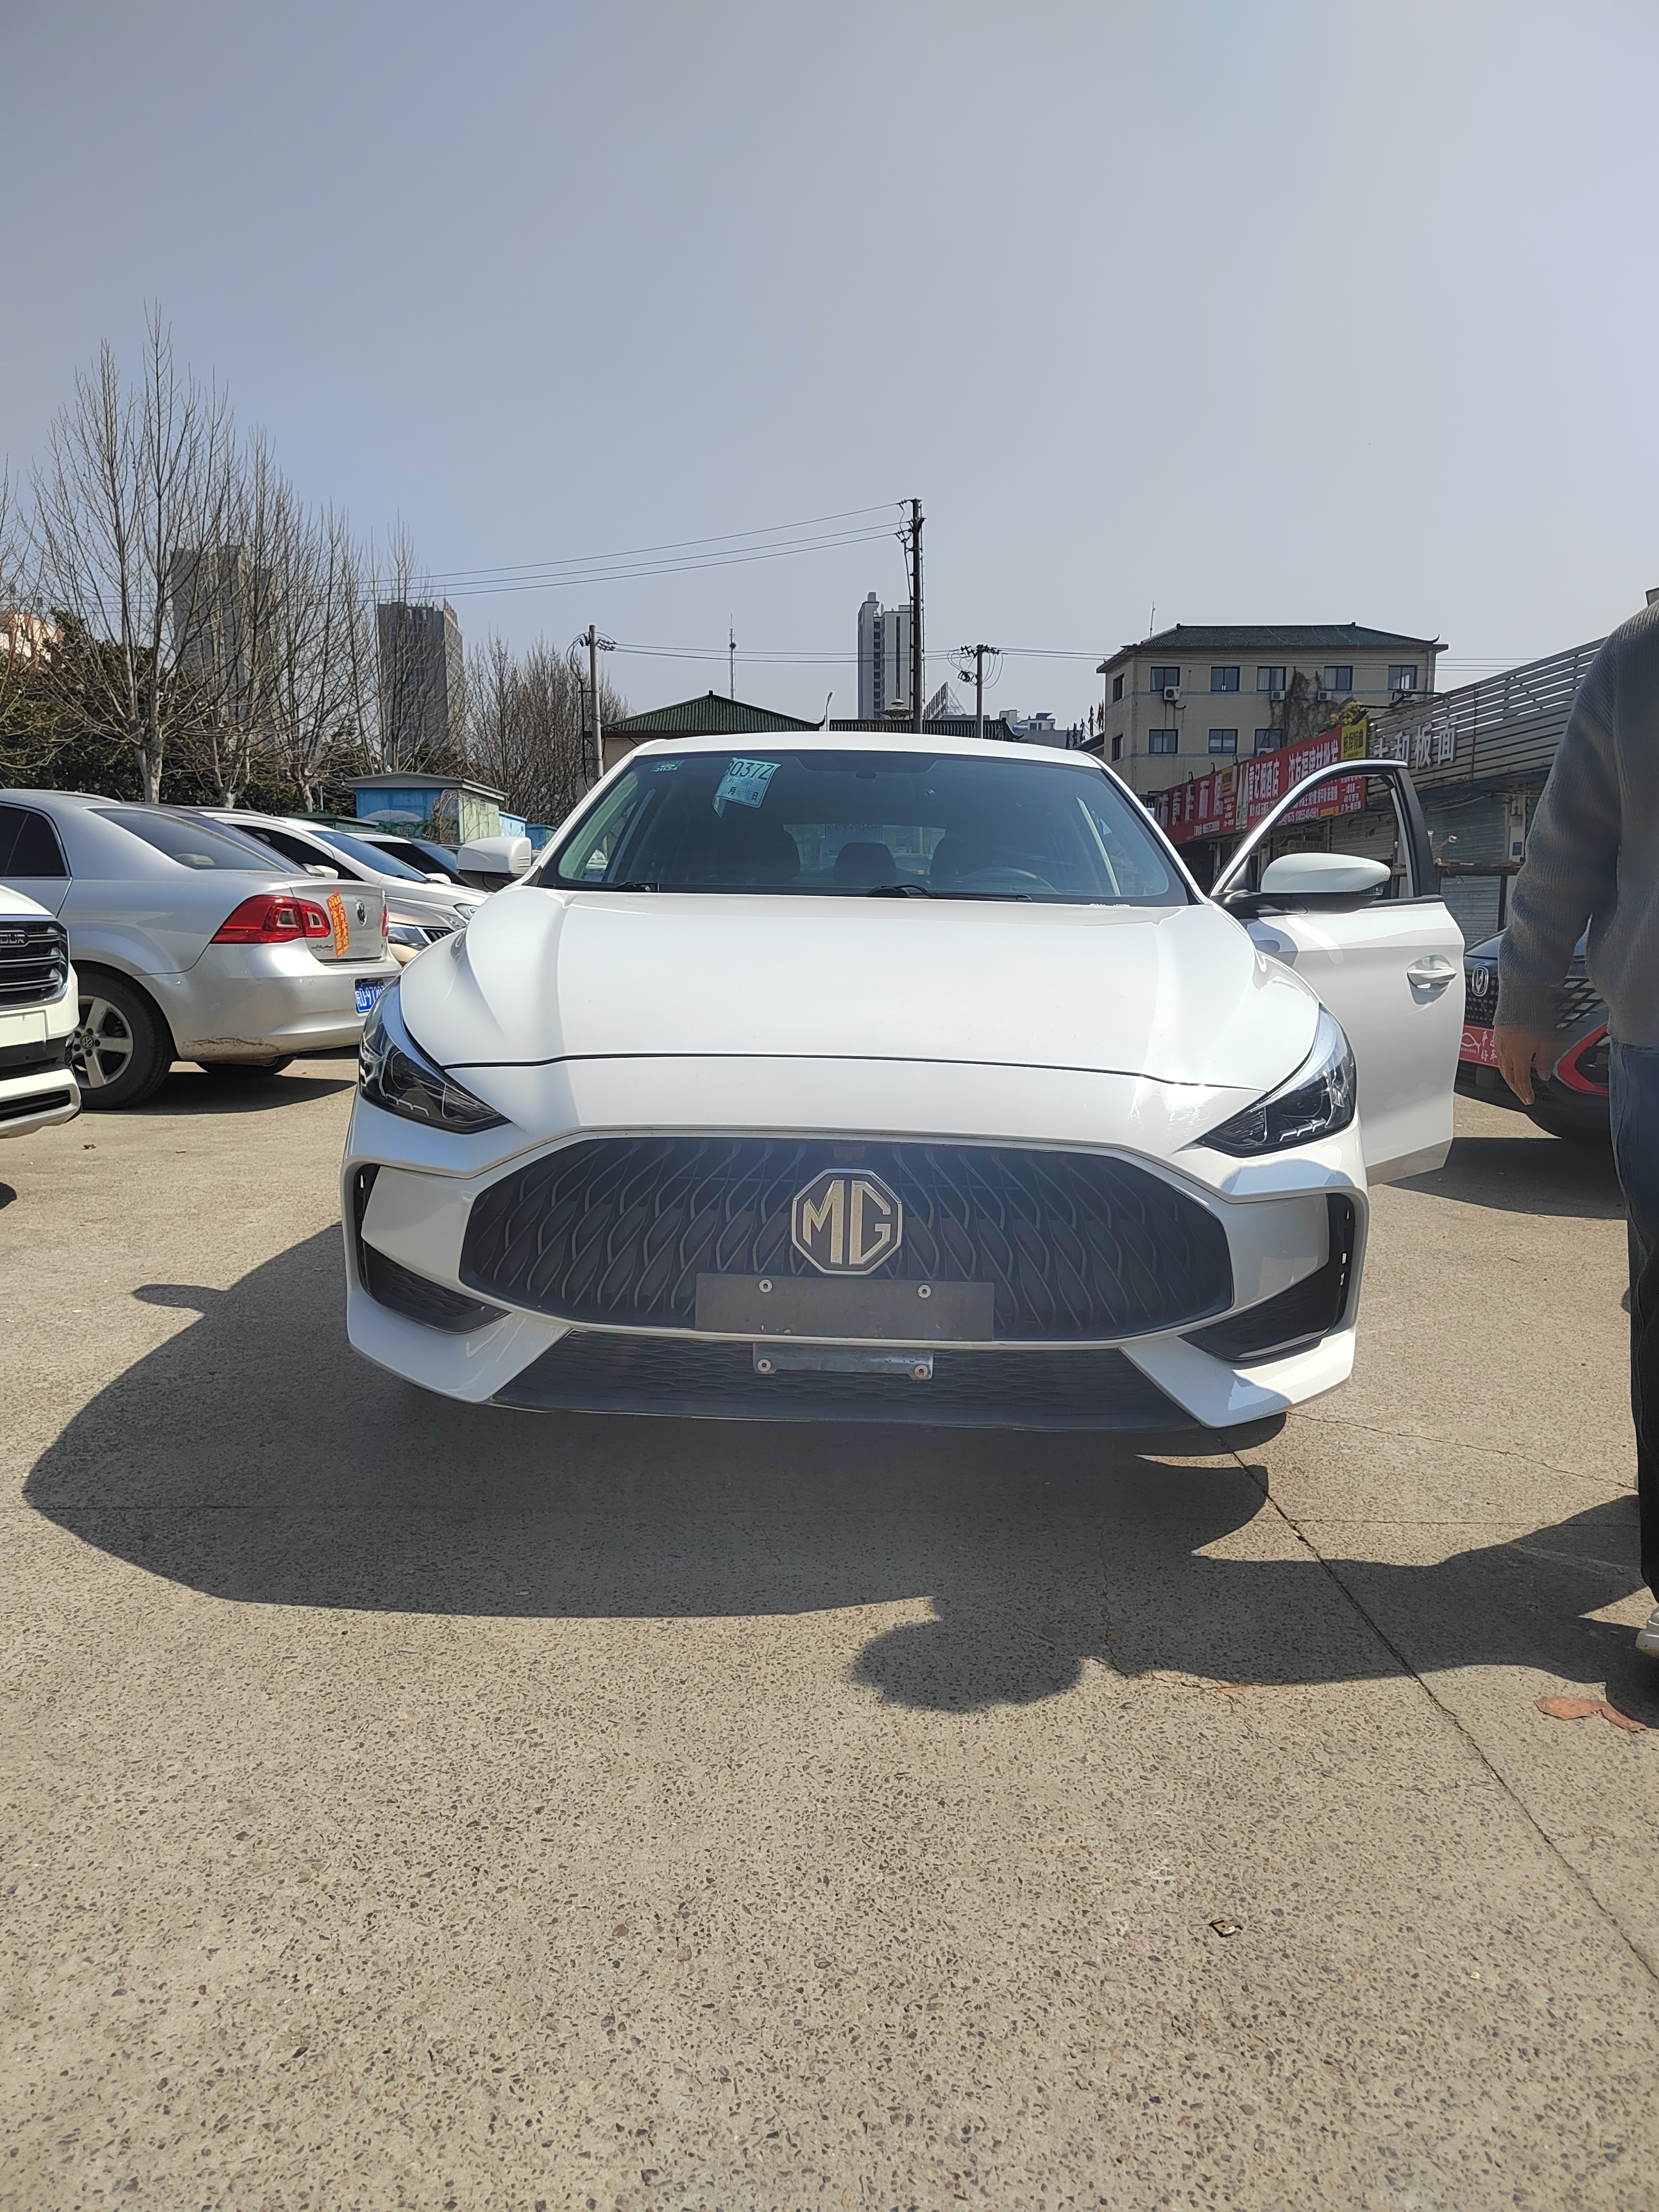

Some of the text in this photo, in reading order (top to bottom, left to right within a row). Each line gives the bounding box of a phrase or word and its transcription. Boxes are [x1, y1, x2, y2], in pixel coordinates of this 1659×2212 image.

[728, 786, 759, 801] 月 日
[803, 1180, 891, 1265] MG
